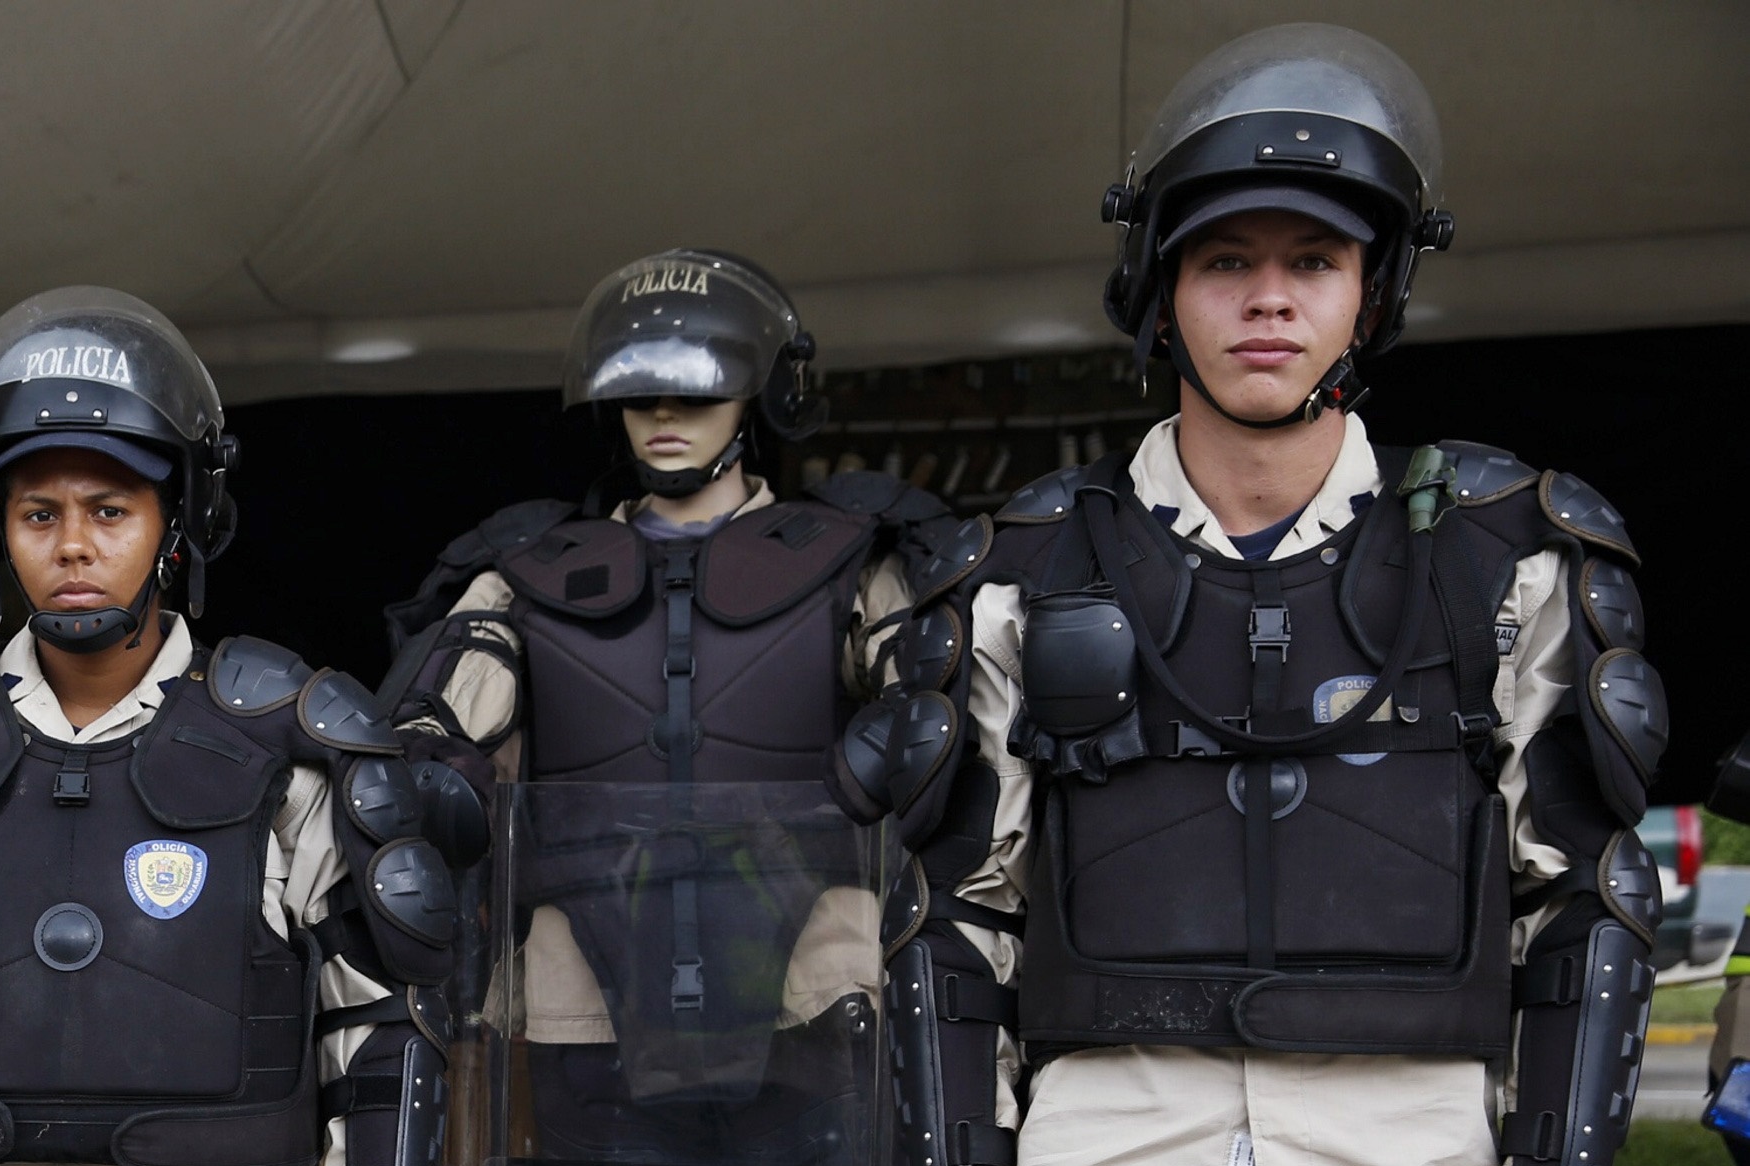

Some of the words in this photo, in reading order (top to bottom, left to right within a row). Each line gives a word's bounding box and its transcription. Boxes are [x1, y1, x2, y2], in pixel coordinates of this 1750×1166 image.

[622, 266, 709, 303] POLICIA
[25, 346, 131, 383] POLICIA
[1496, 629, 1512, 640] AL
[1337, 680, 1374, 690] POLIC
